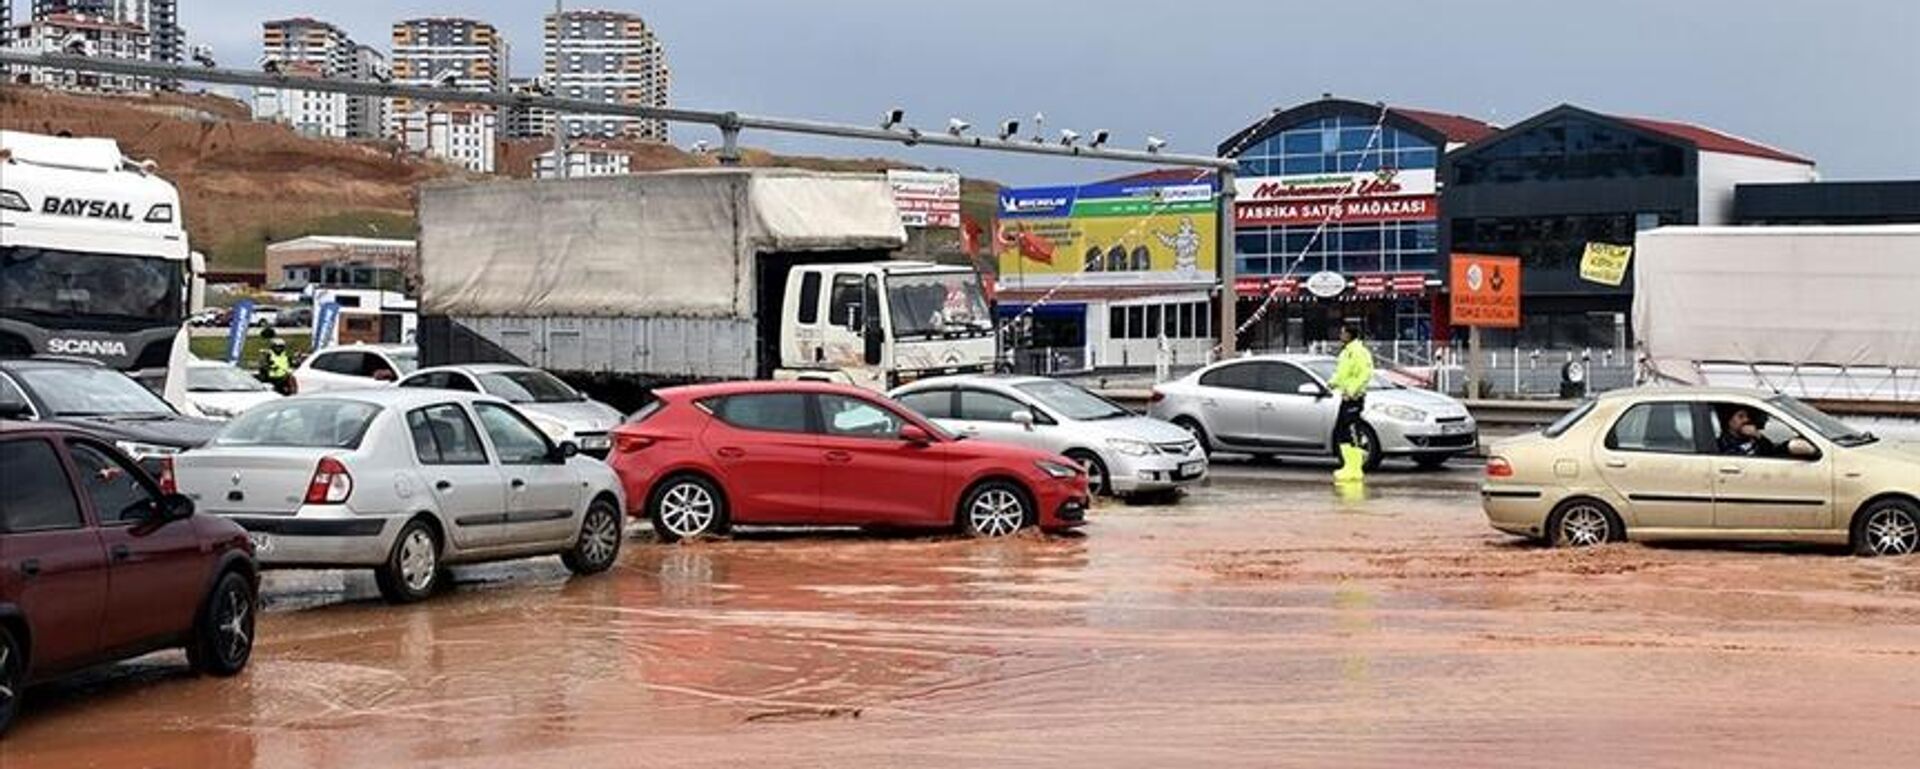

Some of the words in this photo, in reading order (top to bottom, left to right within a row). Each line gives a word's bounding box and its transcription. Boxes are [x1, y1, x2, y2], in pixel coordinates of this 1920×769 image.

[43, 196, 133, 220] BAYSAL
[1238, 204, 1298, 219] FABRİKA
[1302, 203, 1344, 219] SATIŞ
[1348, 200, 1425, 217] MAĞAZASI
[48, 338, 127, 356] SCANIA
